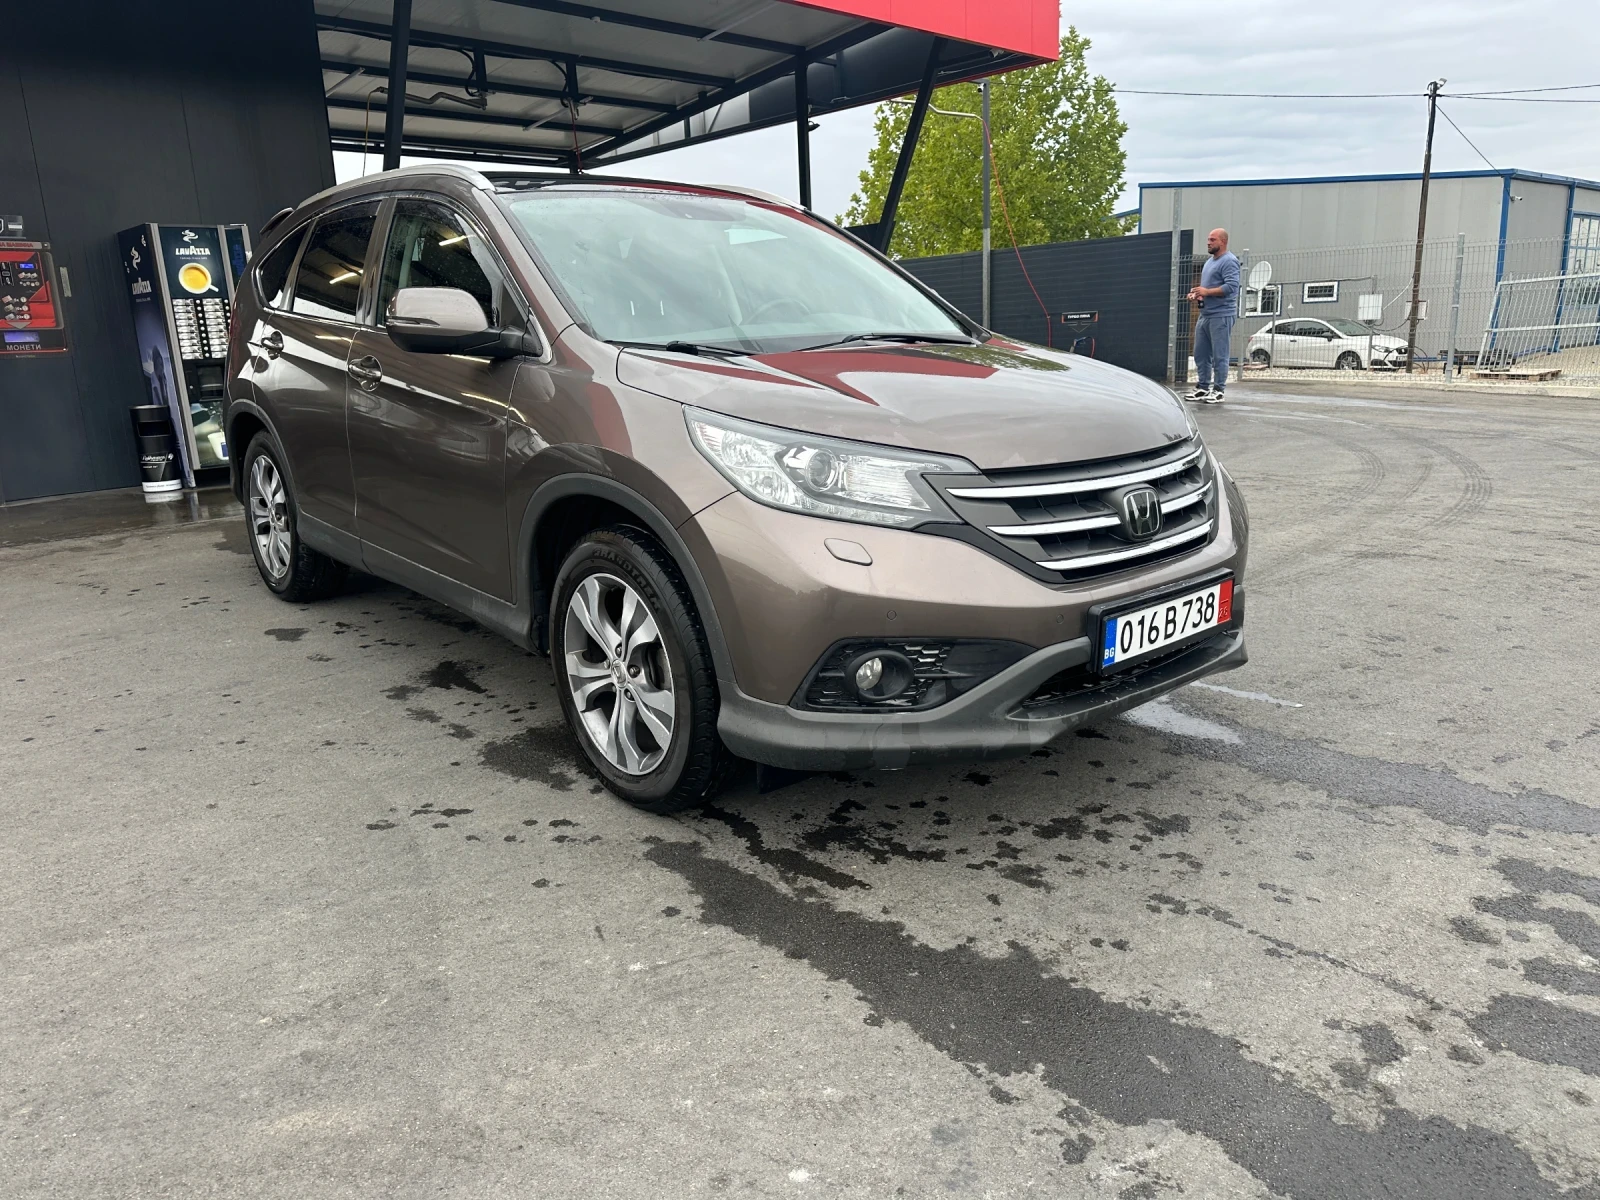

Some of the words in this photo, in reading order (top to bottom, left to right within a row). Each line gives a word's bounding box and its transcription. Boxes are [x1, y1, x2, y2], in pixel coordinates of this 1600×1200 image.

[175, 245, 211, 256] LAVAZZA
[1120, 592, 1215, 654] 016B738
[1104, 647, 1115, 659] BG
